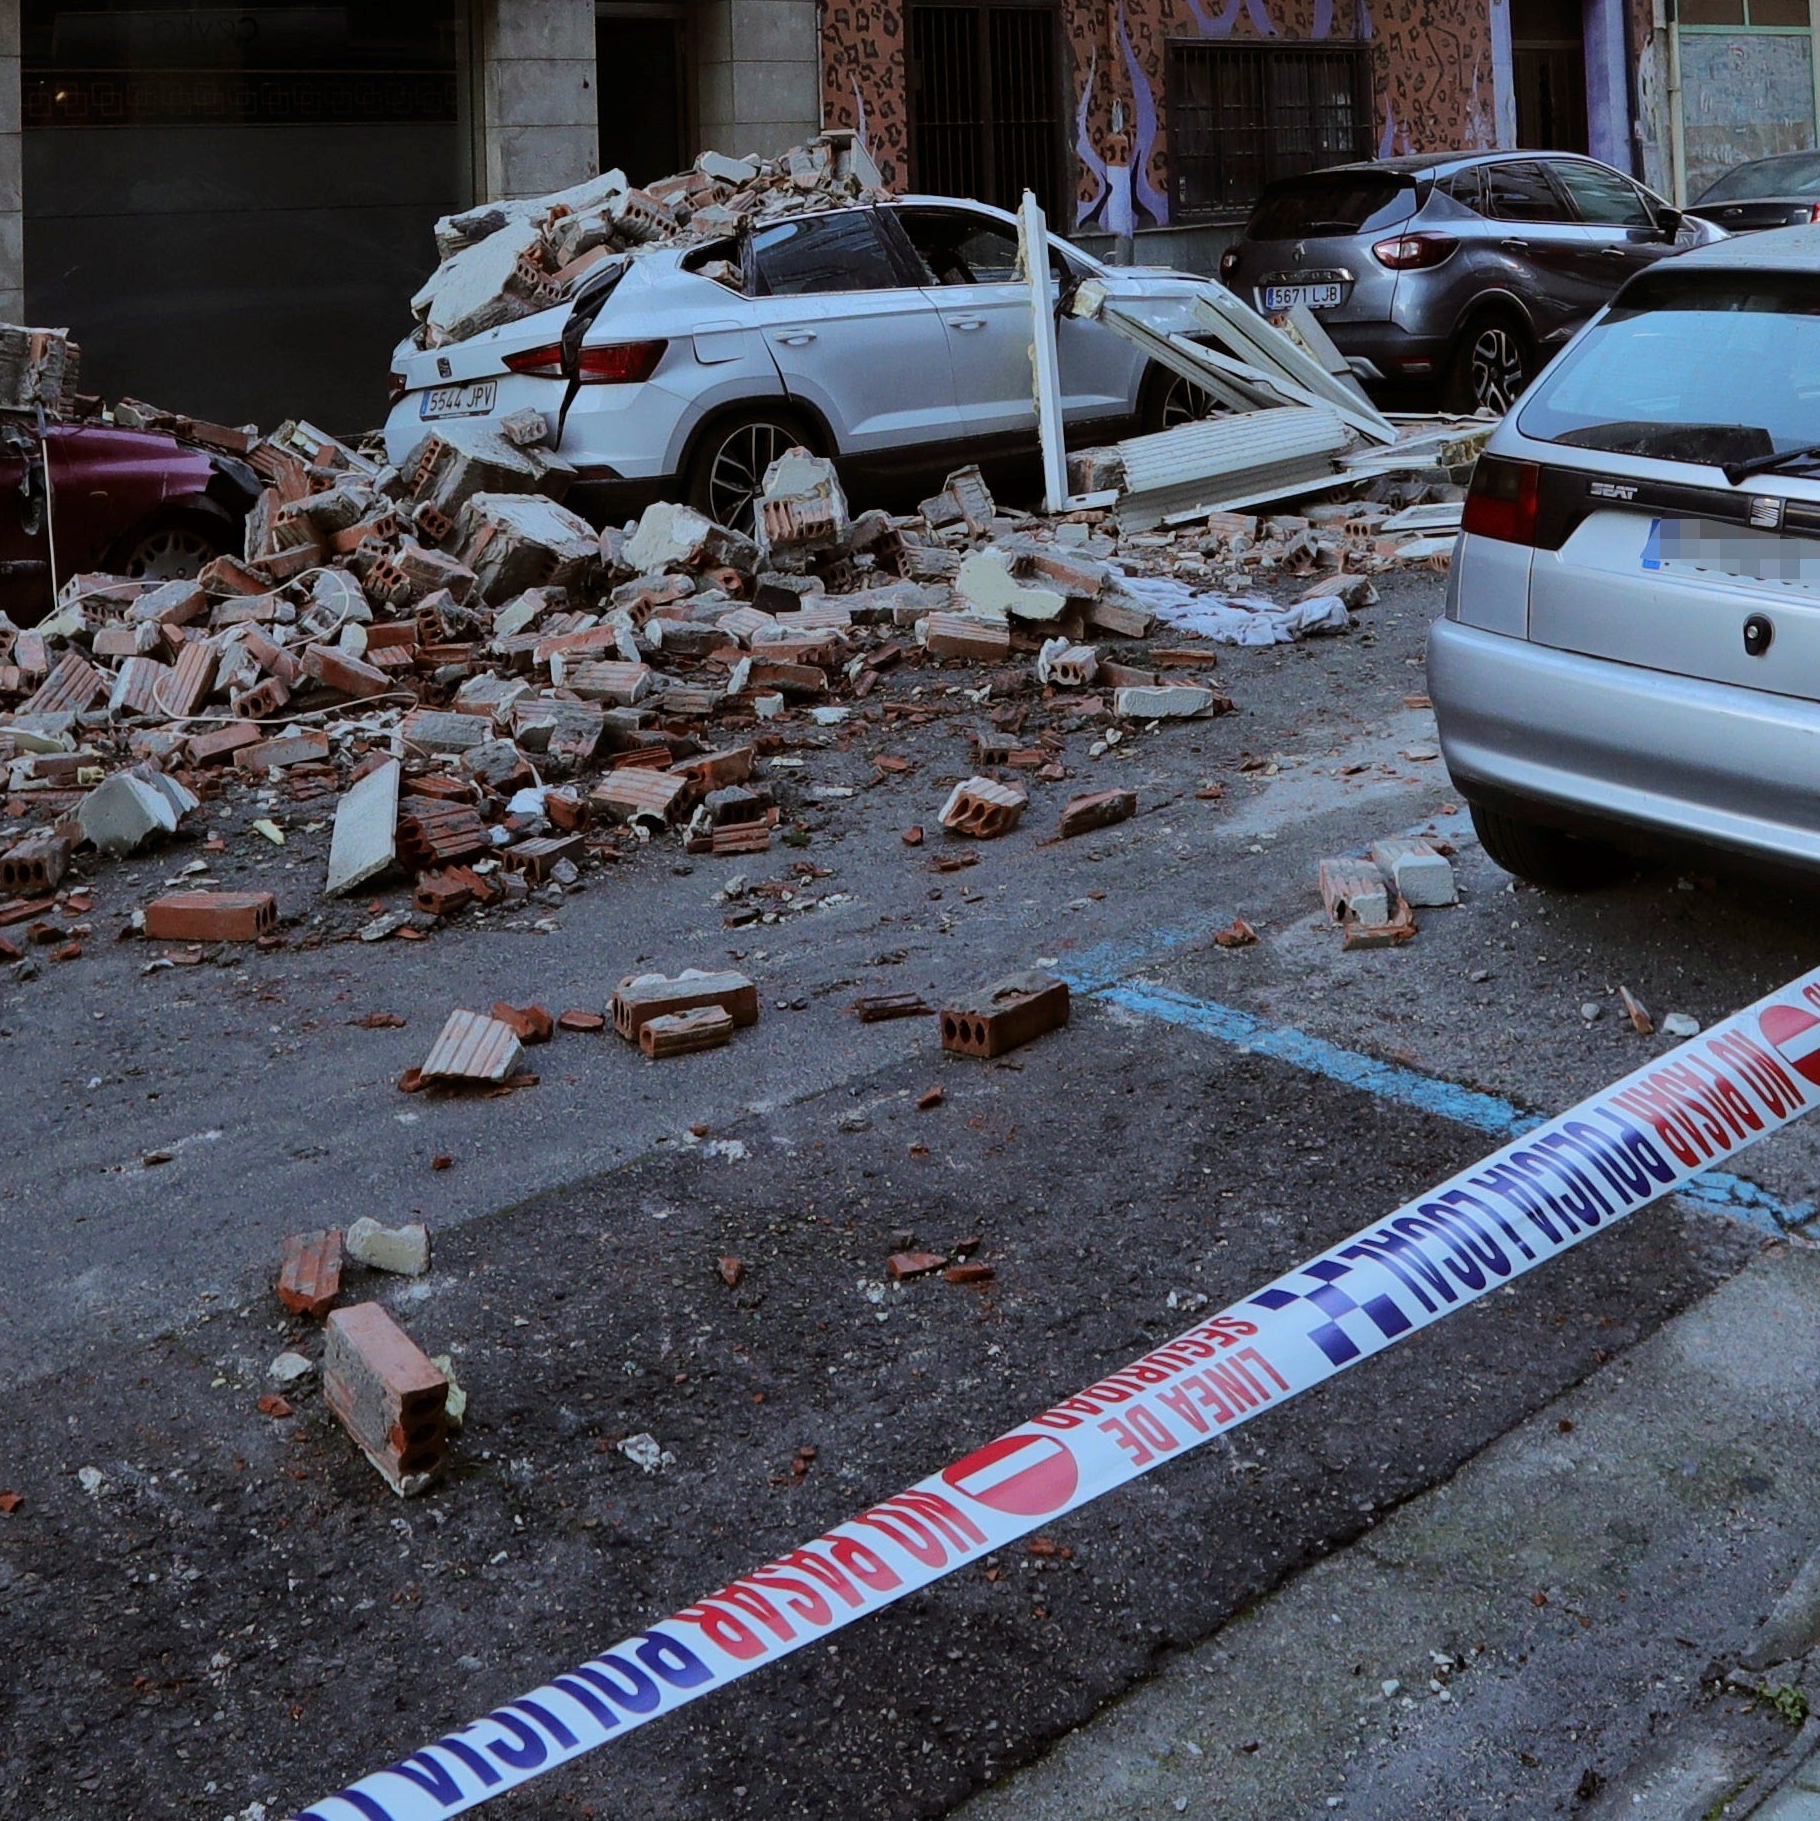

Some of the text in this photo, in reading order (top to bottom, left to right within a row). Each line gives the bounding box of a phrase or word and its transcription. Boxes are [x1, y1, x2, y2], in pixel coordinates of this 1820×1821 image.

[1275, 286, 1338, 304] 5671 LJB
[429, 385, 493, 412] 5544 JPV
[1589, 481, 1638, 501] SEAT
[1336, 1028, 1806, 1314] NO PASAR POLICIA LOCAL
[1031, 1315, 1260, 1431] SEGURIDAD
[1096, 1345, 1290, 1467] LINEA DE
[384, 1487, 988, 1808] NO PASAR POLICIA
